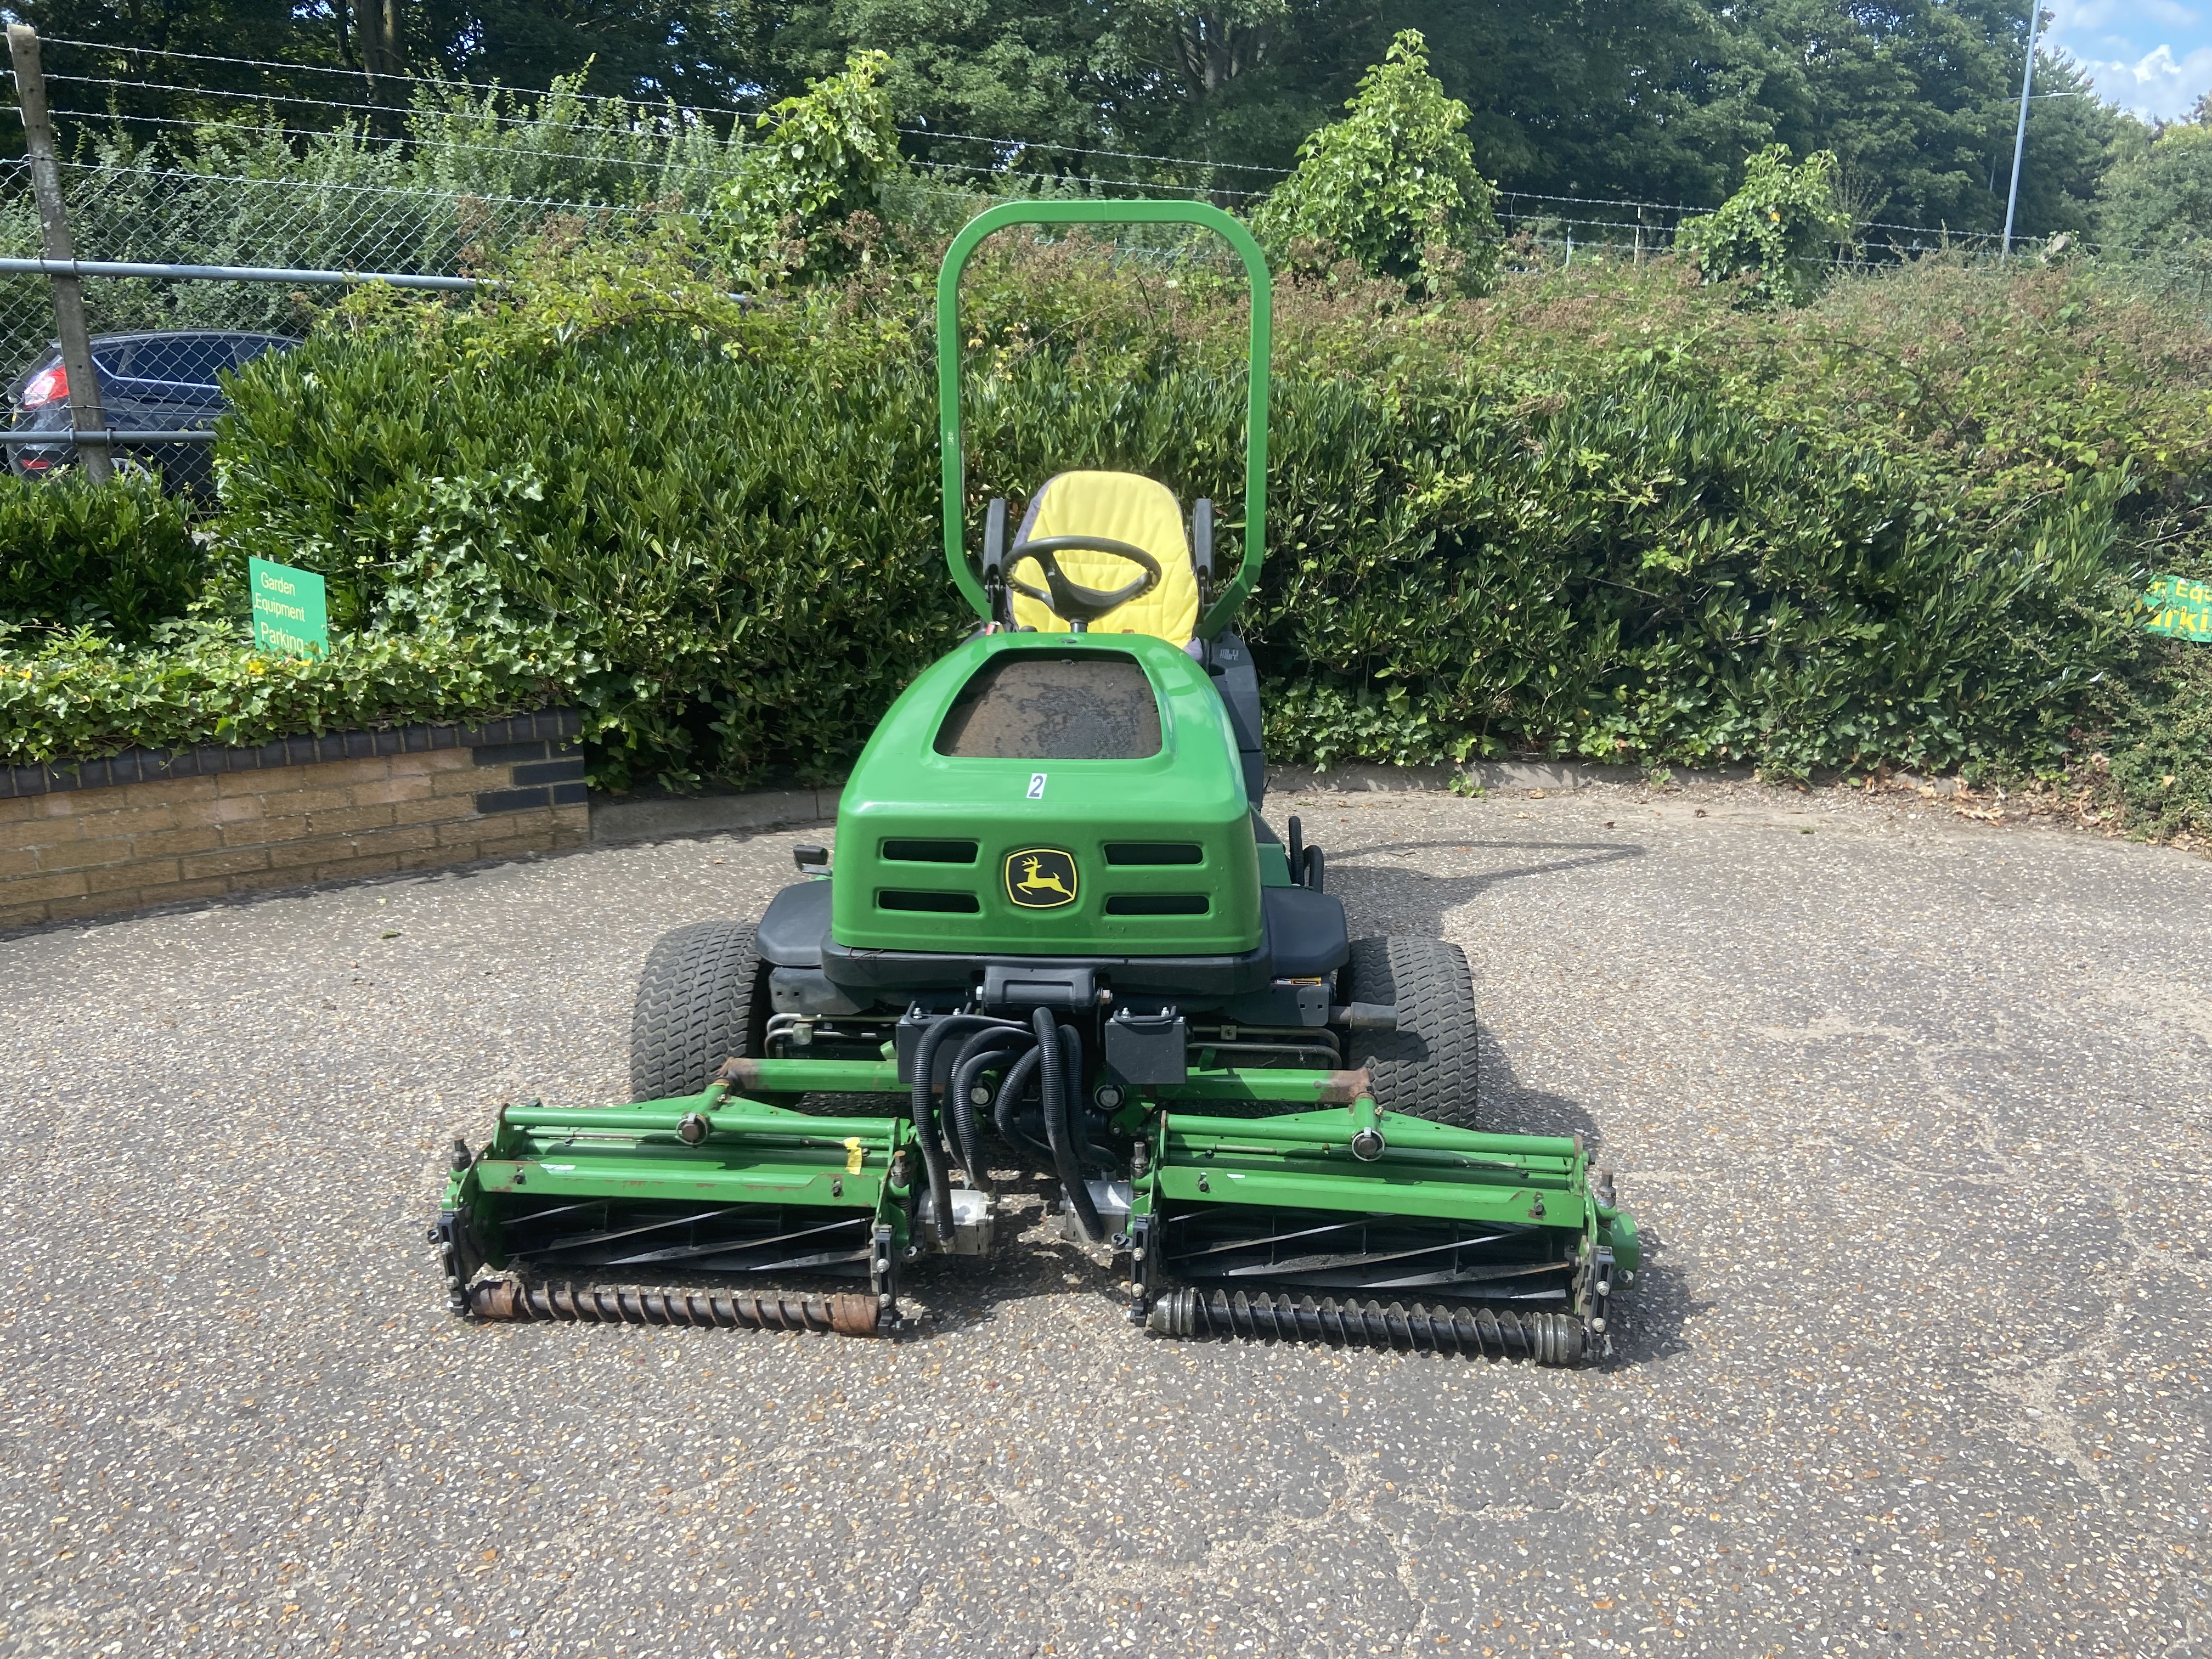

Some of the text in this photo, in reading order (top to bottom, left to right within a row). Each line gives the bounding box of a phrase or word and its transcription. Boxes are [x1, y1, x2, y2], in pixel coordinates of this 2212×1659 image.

[261, 572, 295, 596] Garden
[254, 592, 306, 623] Equipment
[261, 621, 304, 657] Parking
[1028, 775, 1043, 797] 2
